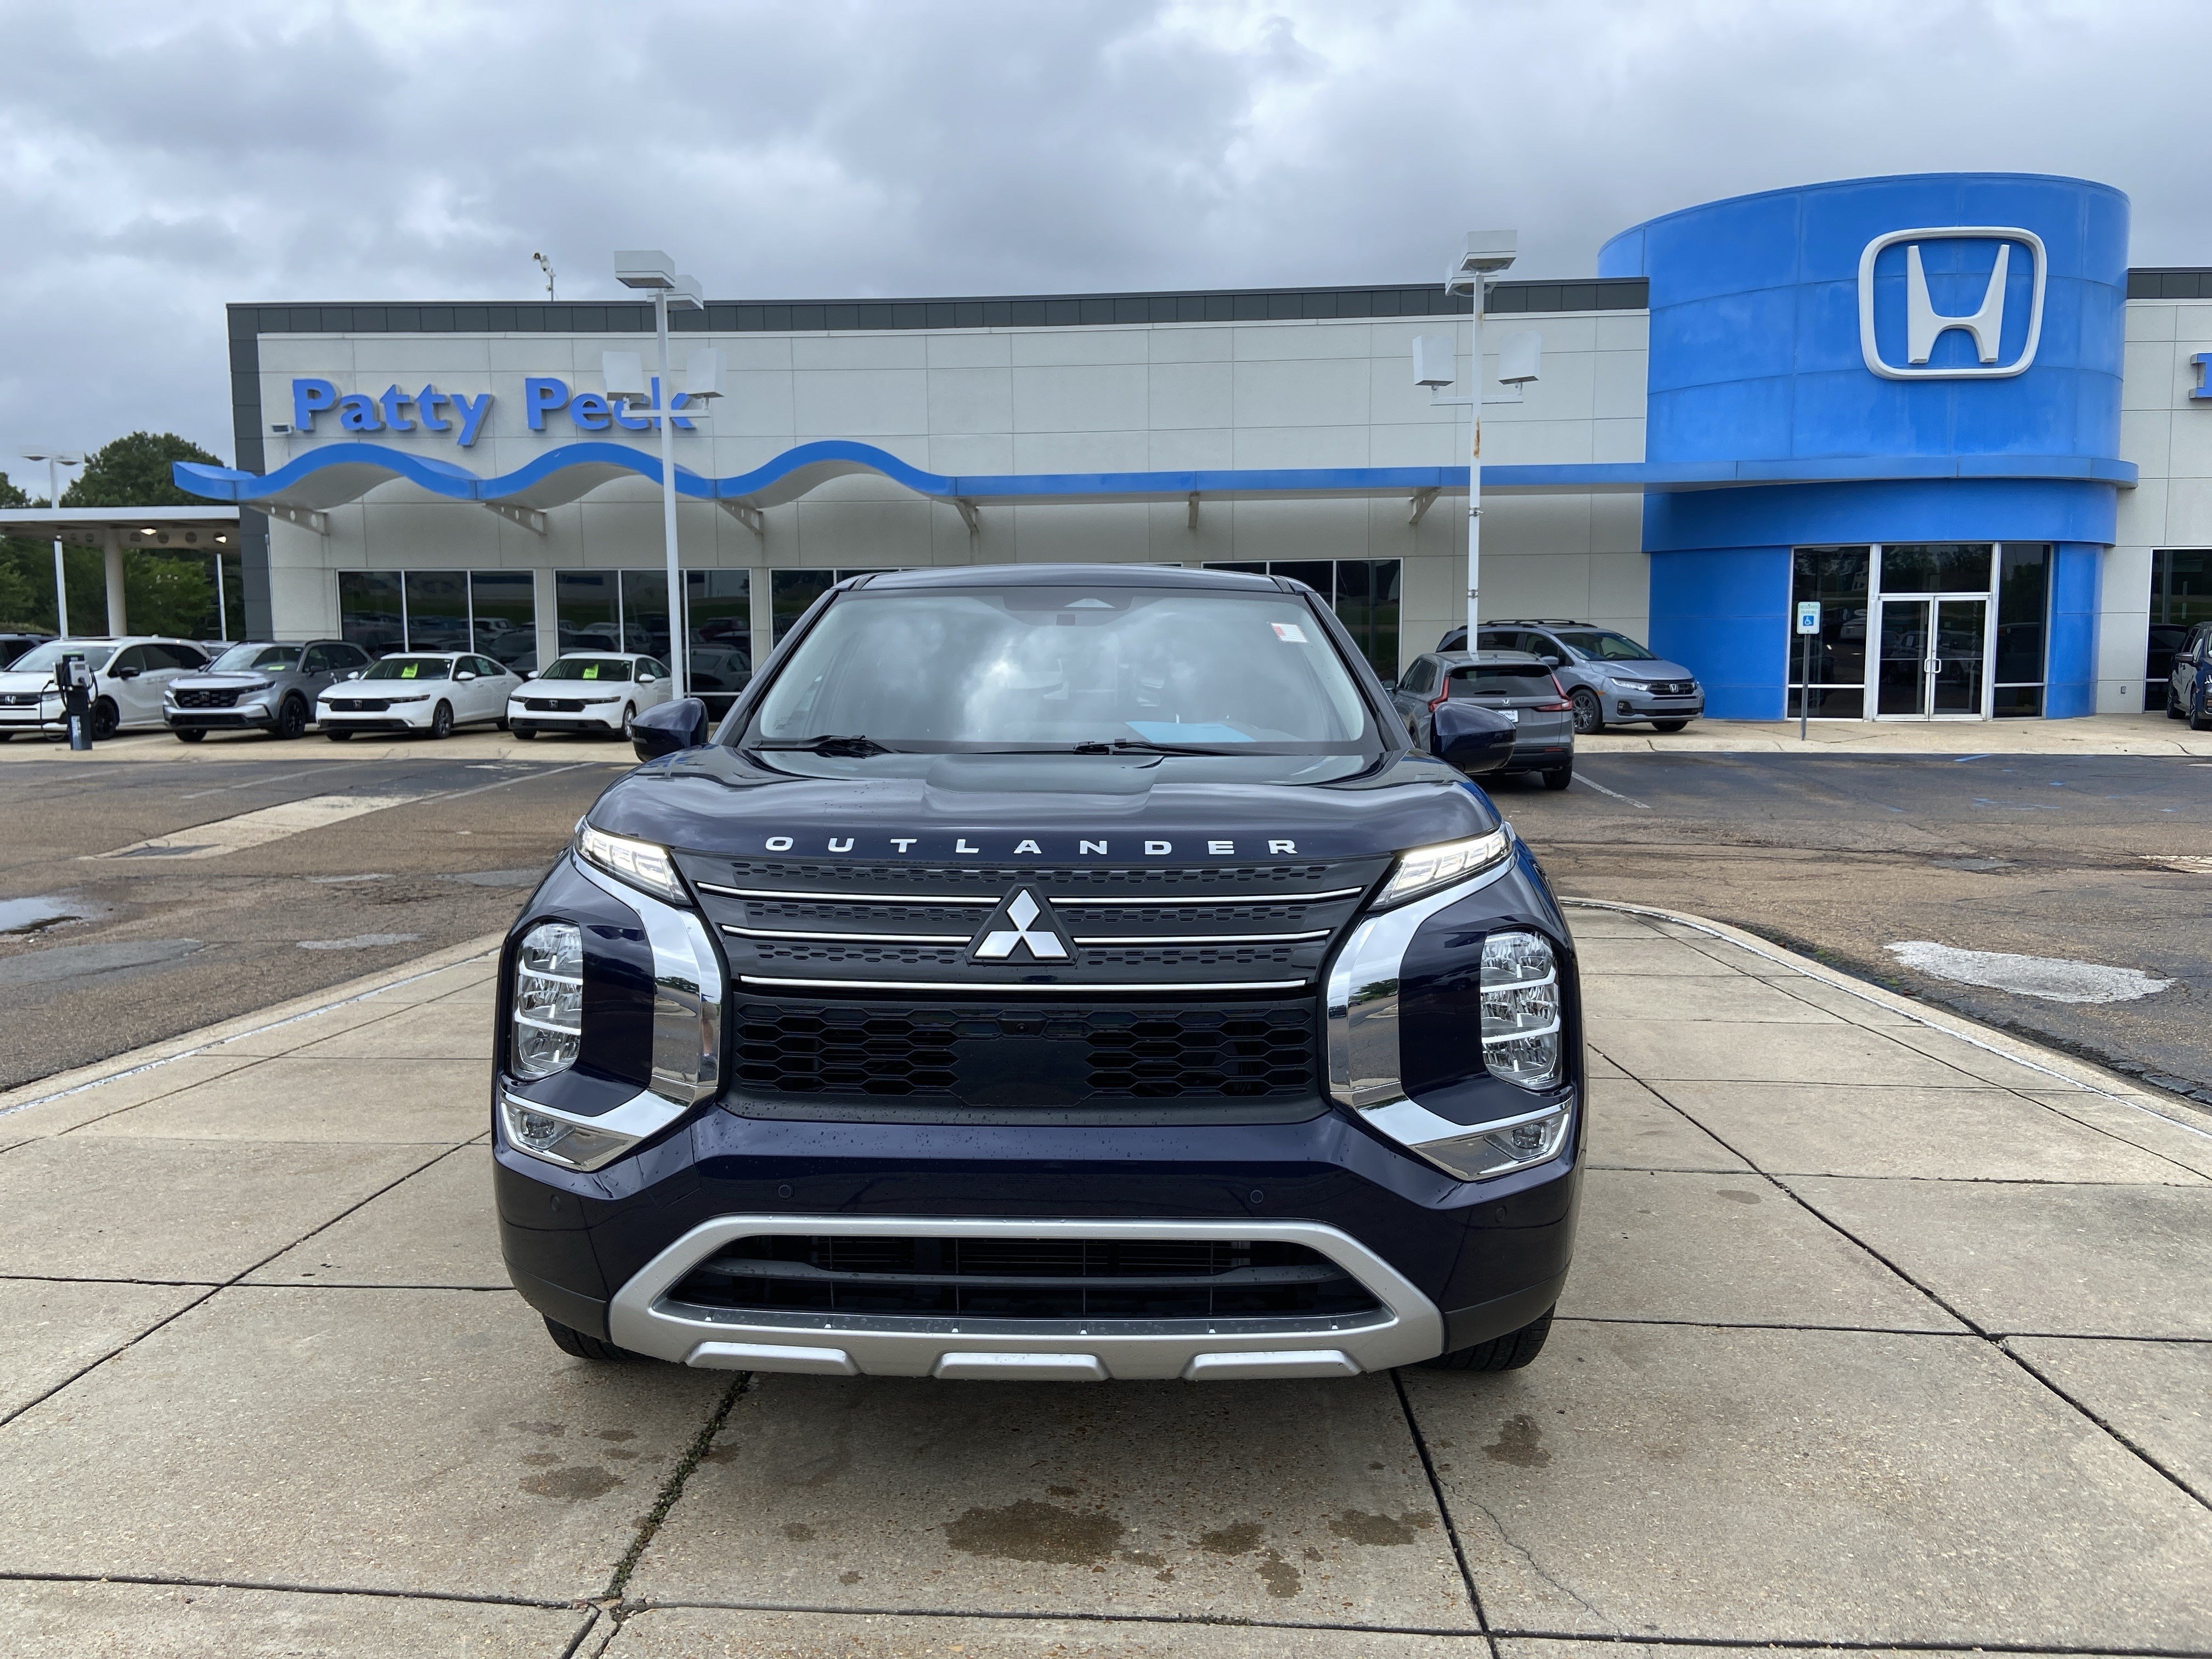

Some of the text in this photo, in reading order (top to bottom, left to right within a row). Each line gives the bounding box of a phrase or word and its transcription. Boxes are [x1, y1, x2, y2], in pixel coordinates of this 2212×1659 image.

[292, 376, 695, 447] Patty Peck
[765, 836, 1298, 855] OUTLANDER
